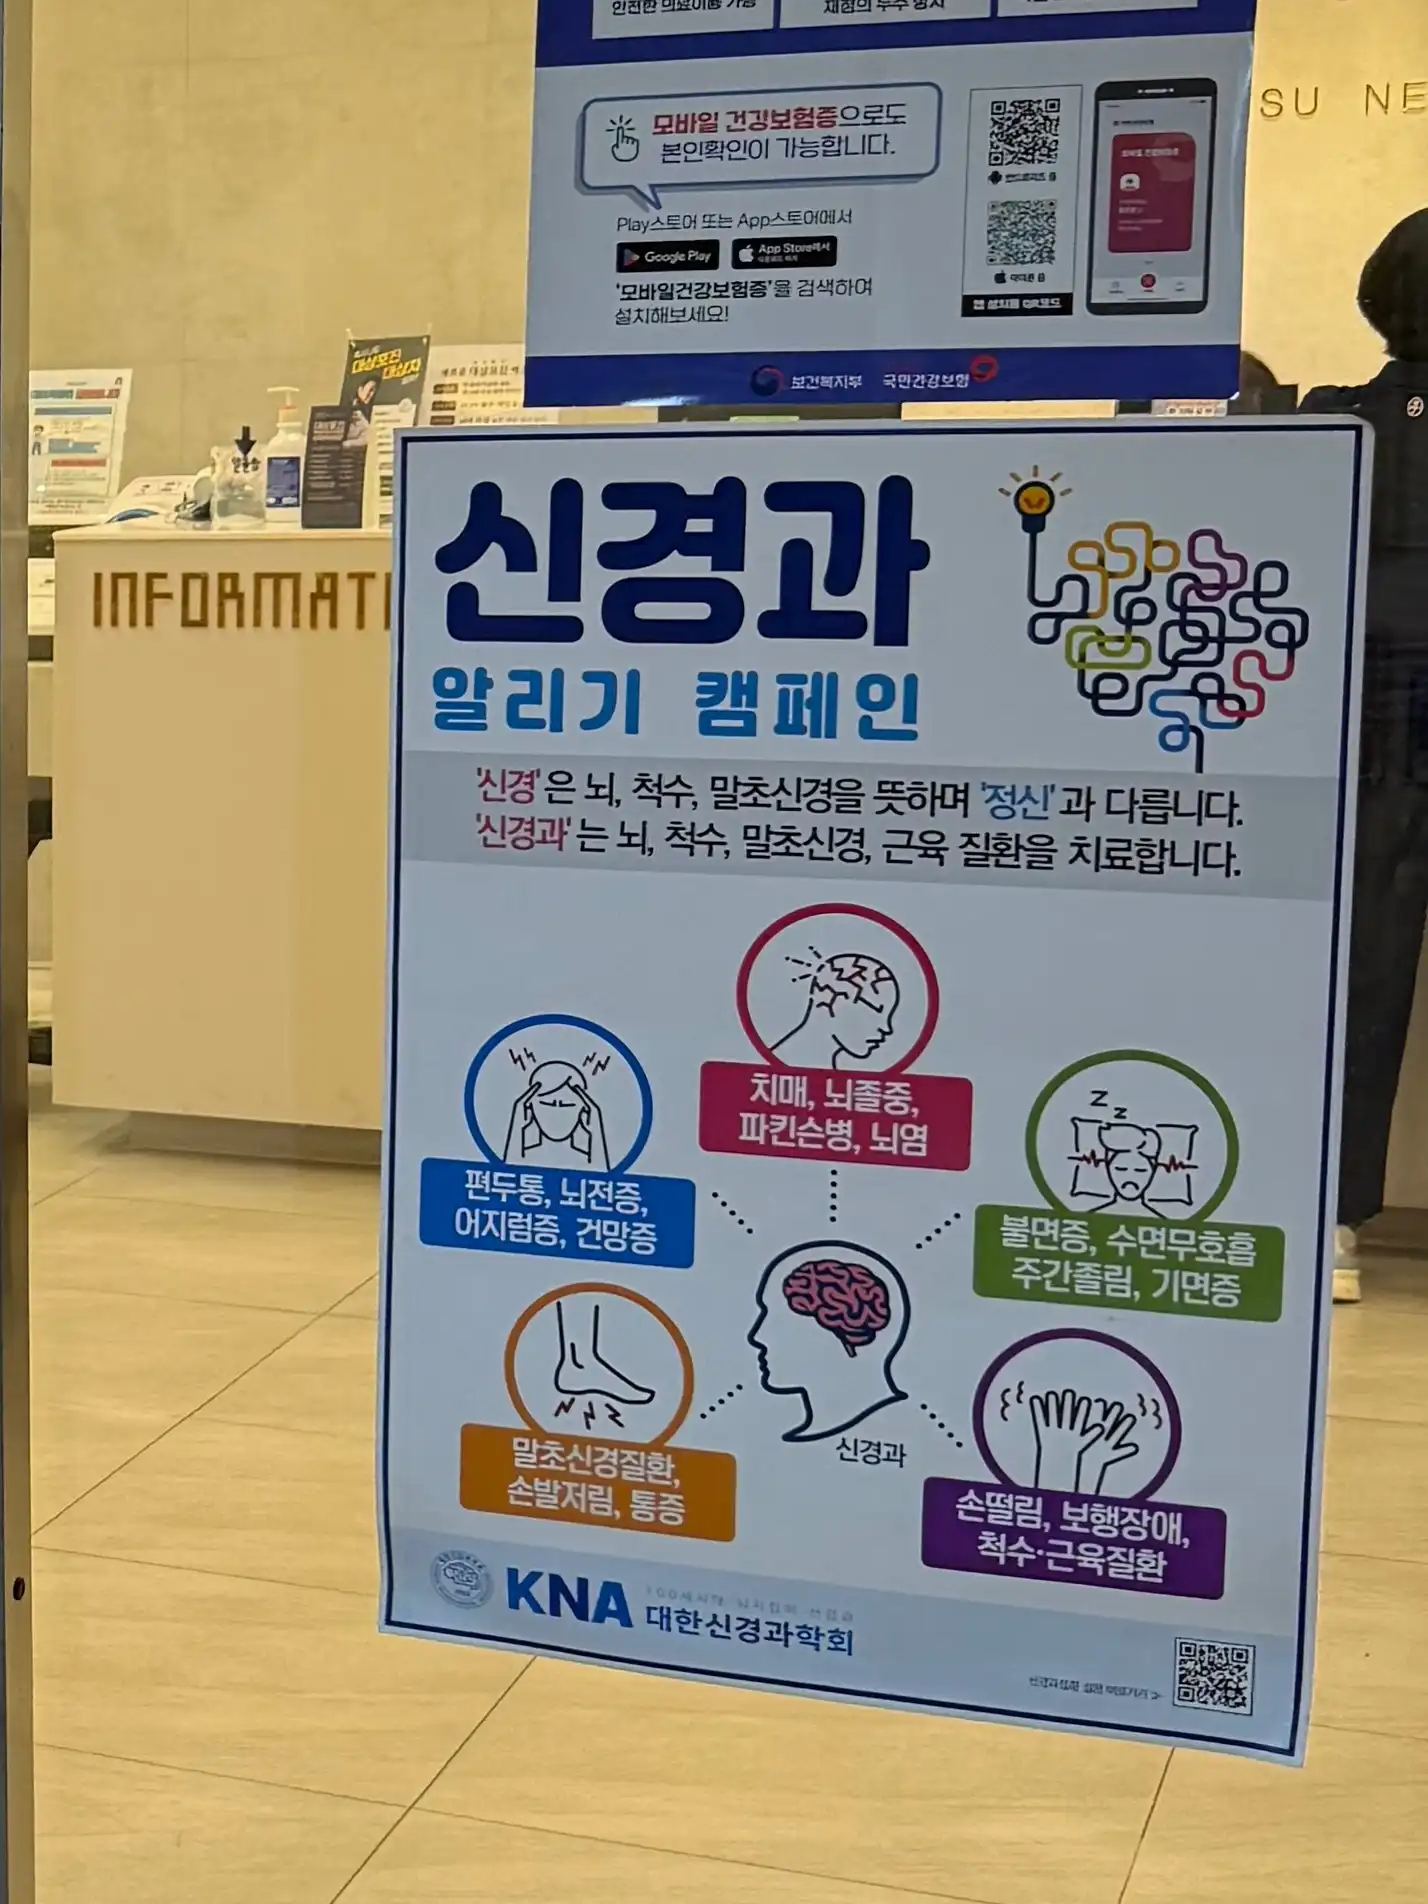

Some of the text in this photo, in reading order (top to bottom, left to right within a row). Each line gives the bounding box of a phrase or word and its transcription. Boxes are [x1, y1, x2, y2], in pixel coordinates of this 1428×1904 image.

[652, 101, 907, 136] 모바일 건강보험증으로도
[660, 133, 896, 165] 본인확인이 가능합니다.
[616, 209, 853, 235] Play스토어 또는 App스토어에서
[644, 249, 712, 265] Google Play
[758, 243, 780, 256] App
[797, 278, 873, 297] 검색하여
[614, 305, 729, 326] 설치해보세요!
[435, 474, 931, 646] 신경과
[93, 572, 391, 631] INFORMATI
[431, 665, 919, 741] 알리기 캠페인
[586, 772, 622, 808] 뇌,
[631, 772, 699, 813] 척수,
[709, 775, 864, 814] 말초신경을
[873, 781, 970, 819] 뜻하며
[1105, 786, 1244, 828] 다릅니다.
[616, 821, 653, 857] 뇌,
[664, 821, 731, 859] 척수,
[742, 823, 871, 864] 말초신경,
[882, 830, 948, 867] 근육
[959, 832, 1059, 871] 질환을
[1067, 836, 1242, 879] 치료합니다.
[750, 1072, 920, 1117] 치매, 뇌졸중,
[738, 1112, 928, 1157] 파킨슨병, 뇌염
[465, 1169, 648, 1217] 편두통, 뇌전증,
[454, 1209, 658, 1256] 어지럼증, 건망증
[999, 1215, 1257, 1268] 불면증, 수면무호흡
[1012, 1258, 1242, 1308] 주간졸림, 기면증
[512, 1437, 680, 1489] 말초신경질환,
[836, 1437, 907, 1468] 신경과
[507, 1477, 686, 1526] 손발저림, 통증
[955, 1489, 1190, 1548] 손떨림, 보행장애,
[506, 1567, 633, 1629] KNA
[646, 1604, 853, 1656] 대한신경과학회
